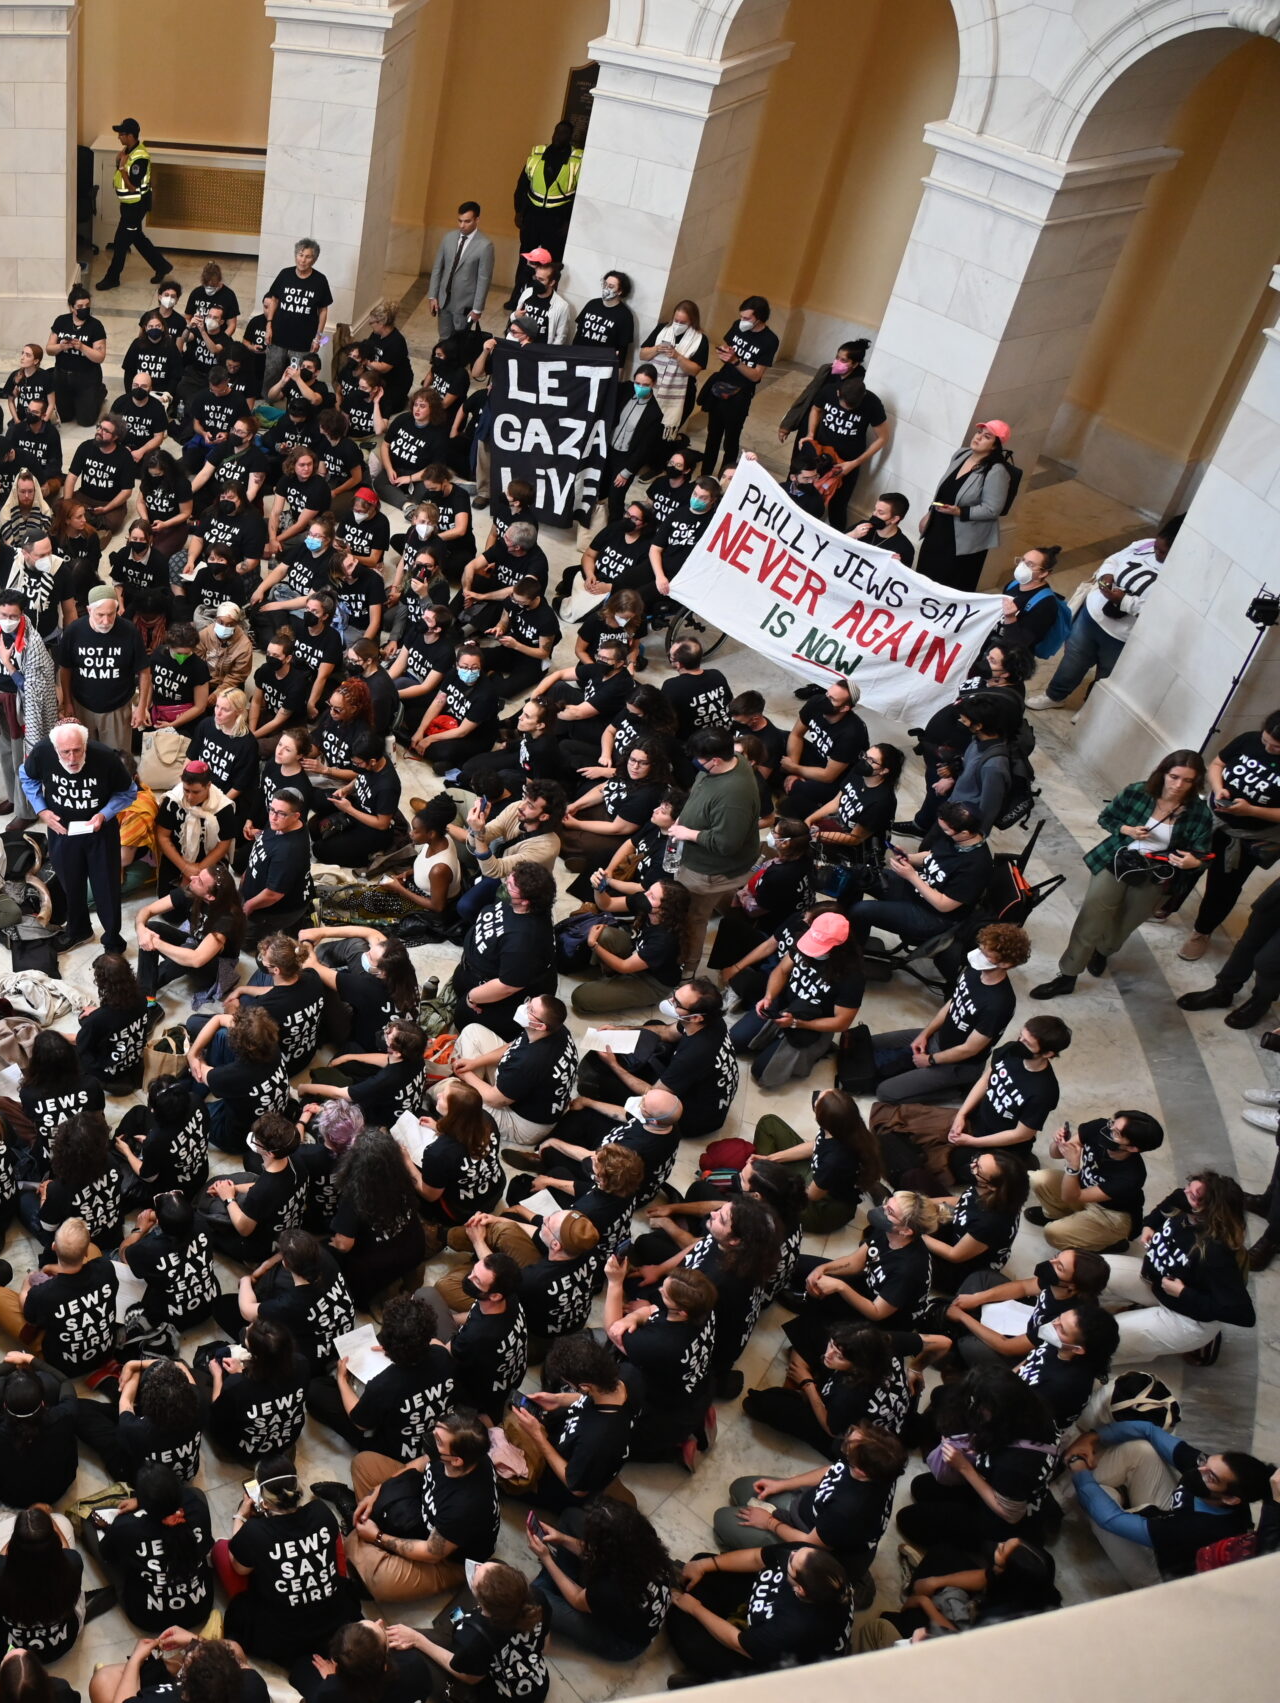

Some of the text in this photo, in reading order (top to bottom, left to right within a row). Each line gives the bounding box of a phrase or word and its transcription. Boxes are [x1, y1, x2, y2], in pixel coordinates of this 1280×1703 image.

[281, 302, 310, 314] NAME
[286, 295, 308, 305] OUR
[585, 313, 614, 328] NOT IN
[585, 321, 606, 333] OUR
[141, 362, 162, 370] OUR
[508, 359, 613, 413] LET
[824, 403, 861, 422] NOT IN
[826, 414, 853, 428] OUR
[397, 428, 414, 443] NOT
[397, 438, 417, 452] OUR
[493, 414, 607, 459] GAZA
[86, 458, 104, 472] NOT
[89, 466, 109, 478] OUR
[84, 473, 113, 488] NAME
[601, 554, 624, 572] OUR
[605, 546, 633, 566] NOT IN
[738, 484, 980, 633] PHILLY JEWS SAY
[1117, 561, 1158, 596] 10
[706, 513, 962, 684] NEVER AGAIN
[760, 603, 863, 676] IS NOW
[79, 648, 103, 656] NOT
[84, 658, 114, 667] OUR
[80, 668, 119, 679] NAME
[155, 665, 187, 683] NOT IN
[155, 674, 180, 691] OUR
[690, 686, 724, 709] JEWS
[698, 699, 724, 716] SAY
[203, 747, 228, 769] OUR
[224, 751, 234, 761] IN
[1239, 754, 1266, 774] NOT
[52, 774, 96, 787] NOT IN
[1233, 765, 1269, 792] OUR
[52, 795, 98, 809] NAME
[58, 786, 91, 798] OUR
[791, 966, 817, 996] OUR
[110, 1014, 147, 1042] JEWS
[990, 1073, 1012, 1109] OUR
[994, 1061, 1024, 1106] NOT IN
[35, 1091, 88, 1114] JEWS
[170, 1109, 204, 1153] JEWS
[72, 1169, 120, 1206] JEWS
[548, 1256, 597, 1296] JEWS
[55, 1284, 112, 1321] JEWS
[58, 1314, 114, 1342] CEASE
[66, 1305, 106, 1331] SAY
[71, 1330, 112, 1353] FIRE
[247, 1388, 303, 1420] JEWS
[400, 1379, 454, 1414] JEWS
[269, 1527, 330, 1560] JEWS
[281, 1548, 328, 1579] SAY
[275, 1563, 336, 1593] CEASE
[148, 1583, 206, 1611] NOW
